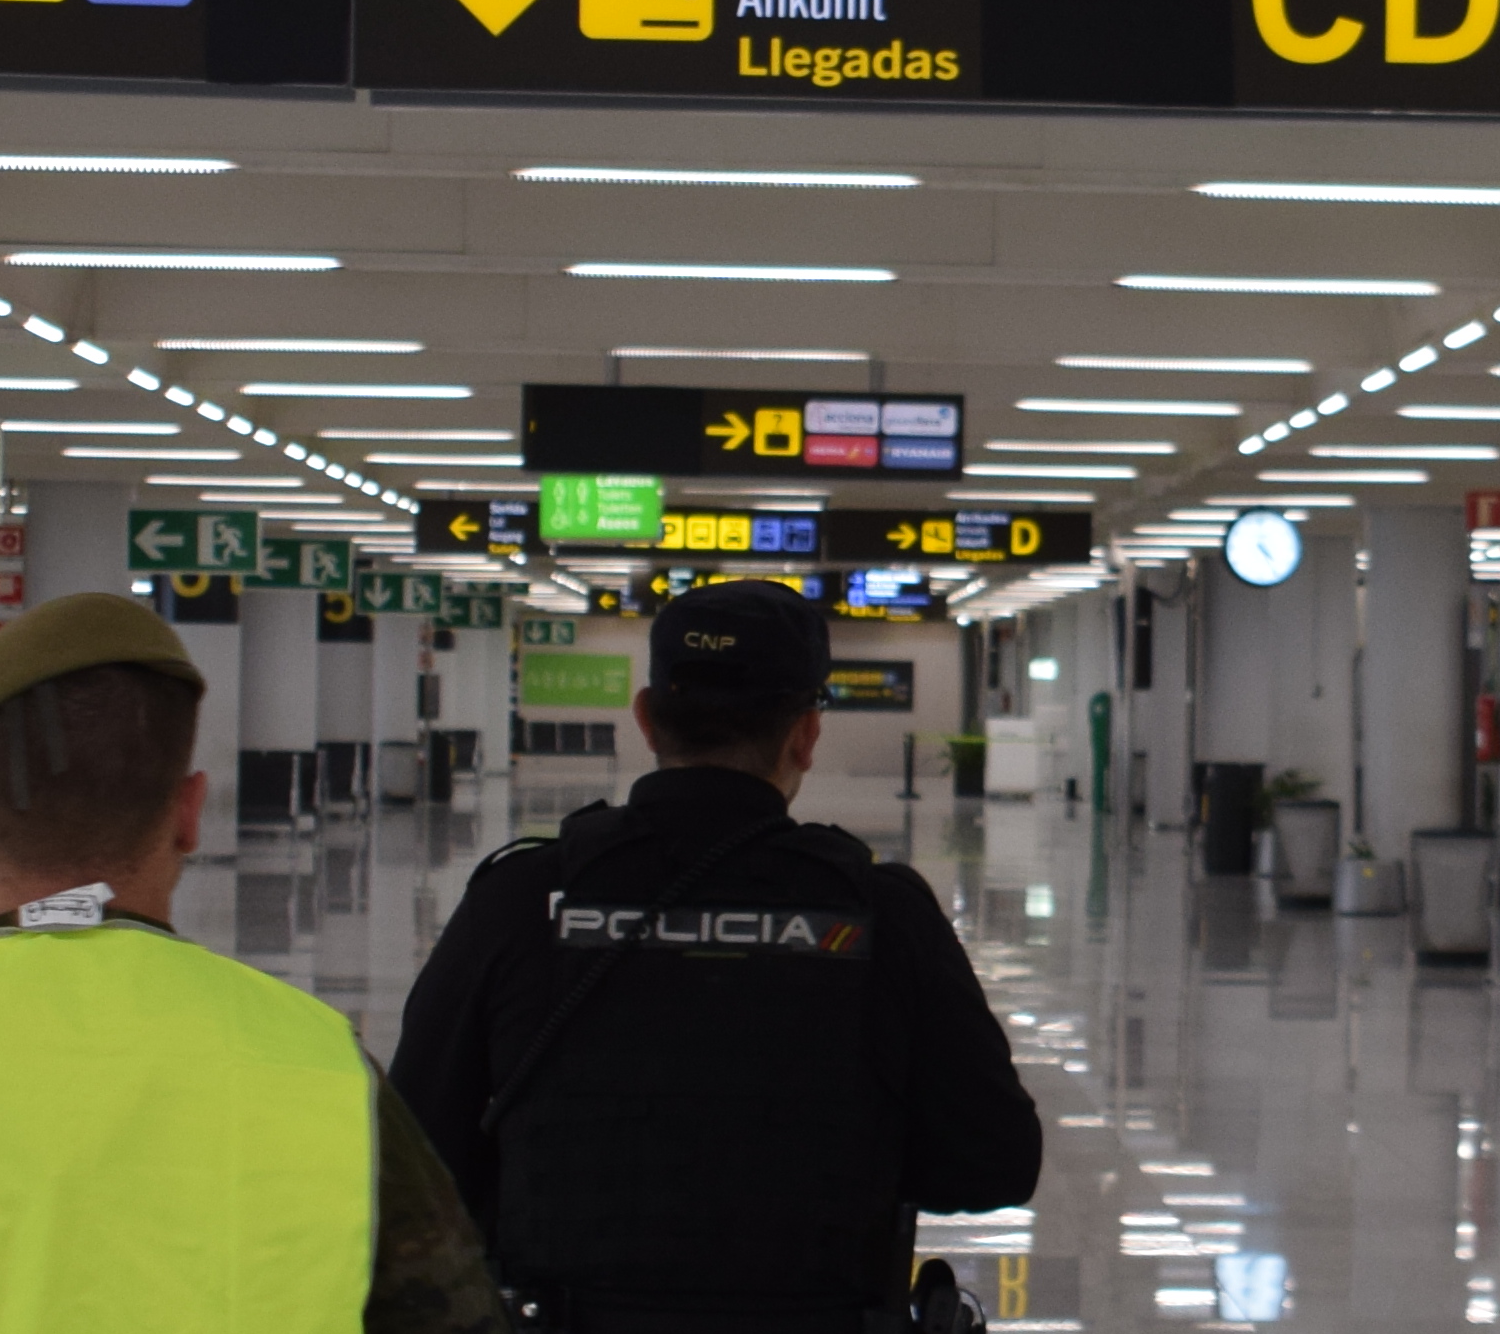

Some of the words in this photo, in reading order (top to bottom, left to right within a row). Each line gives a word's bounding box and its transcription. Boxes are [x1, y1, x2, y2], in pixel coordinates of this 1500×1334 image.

[737, 36, 961, 88] Llegadas
[1011, 520, 1040, 555] D
[684, 631, 737, 651] CNP
[560, 908, 817, 945] POLICIA
